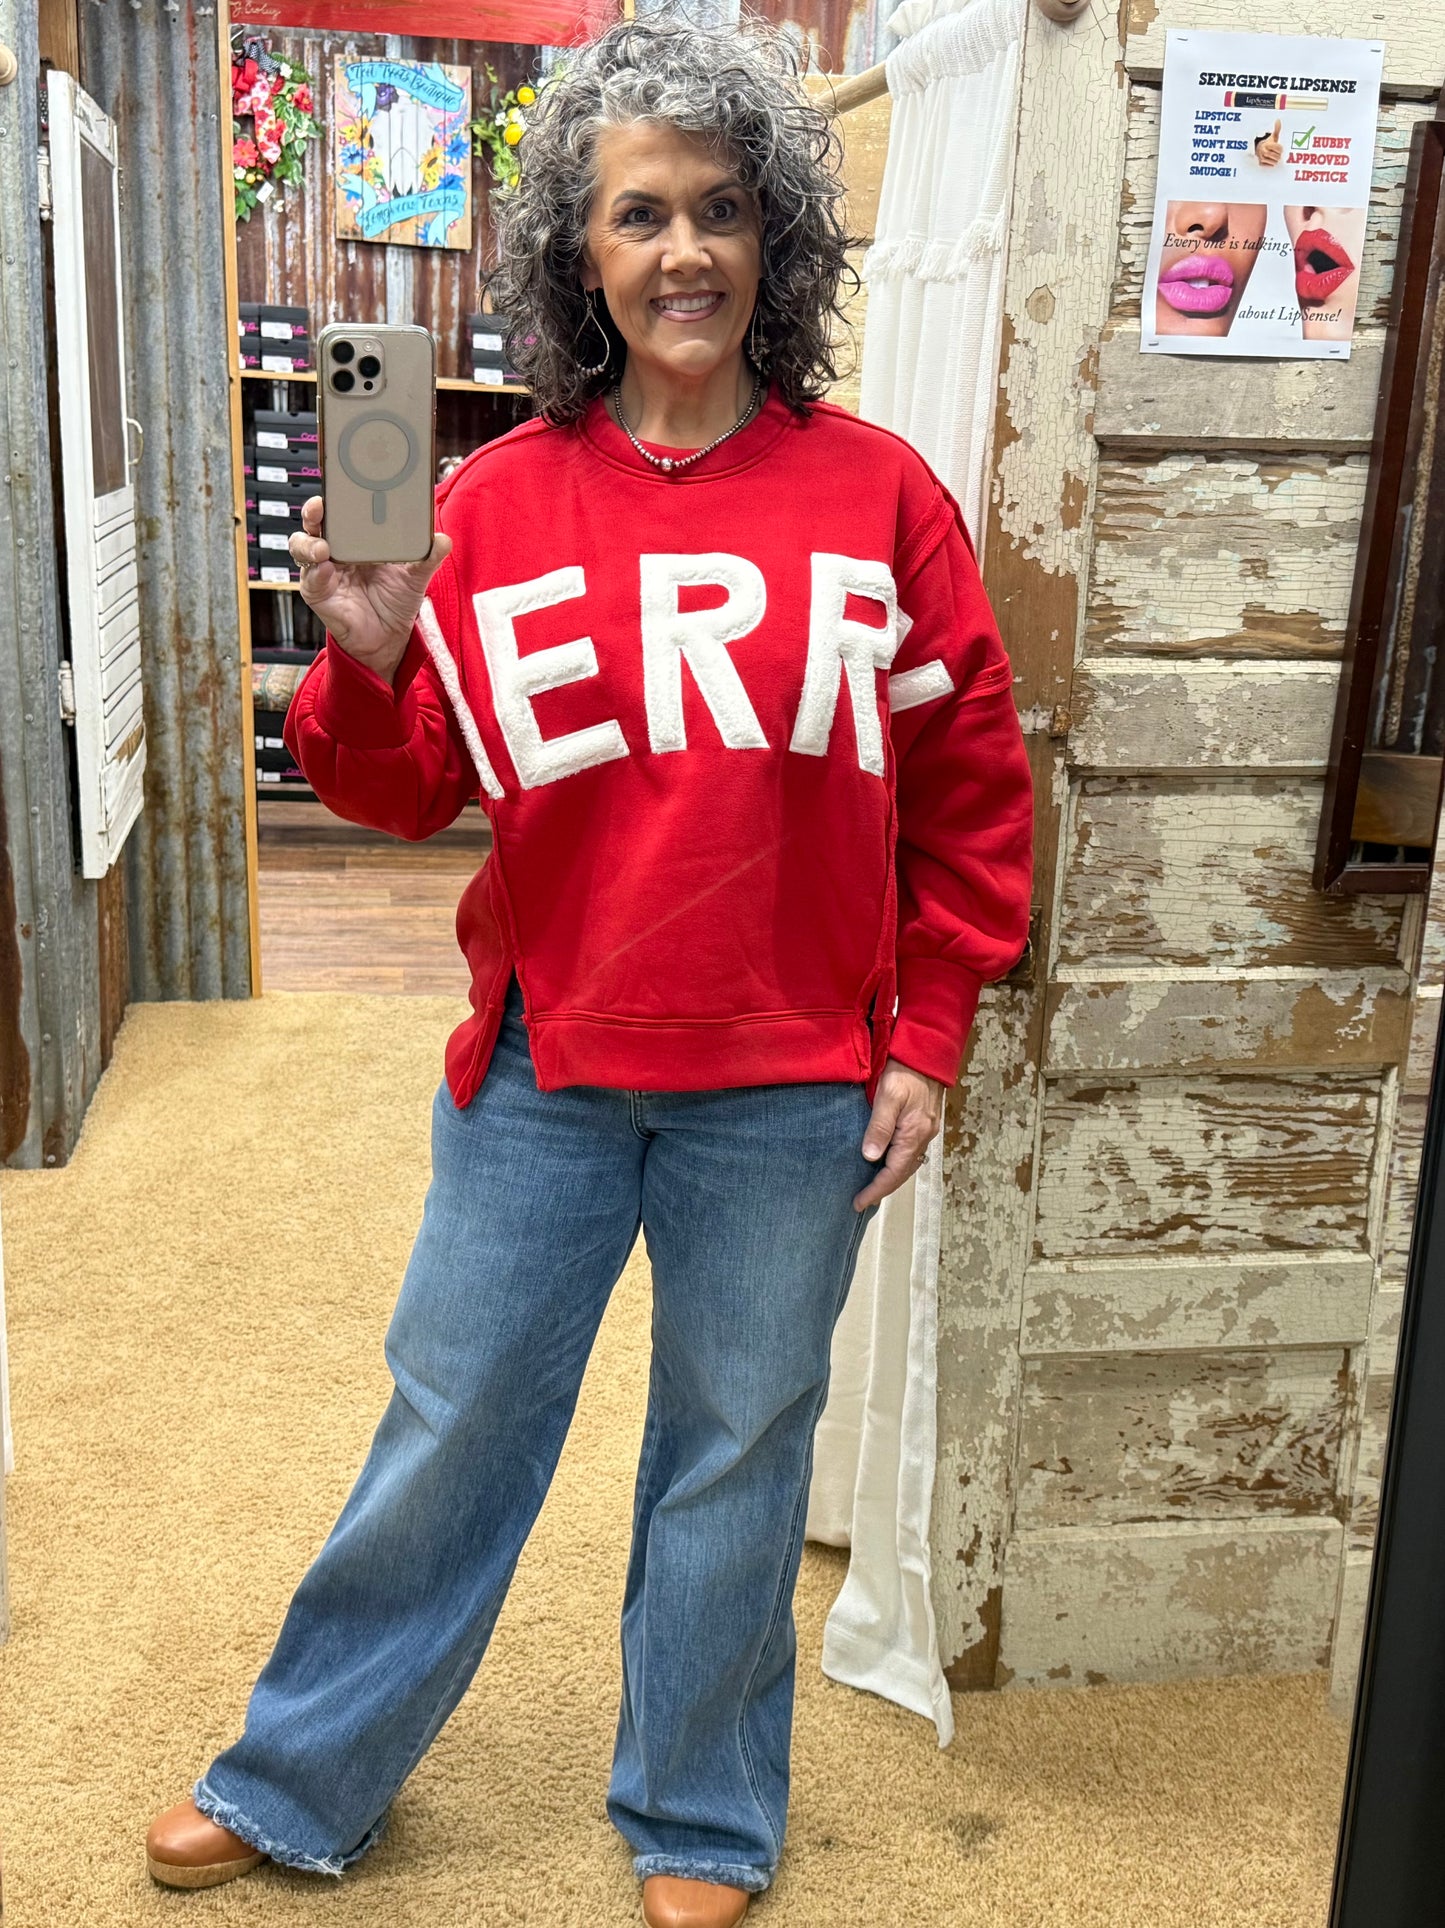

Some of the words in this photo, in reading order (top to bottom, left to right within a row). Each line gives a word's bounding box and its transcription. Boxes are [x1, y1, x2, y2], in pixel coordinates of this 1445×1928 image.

[1199, 72, 1288, 90] SENEGENCE
[1290, 77, 1357, 93] LIPSENSE
[1195, 111, 1242, 122] LIPSTICK
[1194, 125, 1220, 135] THAT
[1192, 138, 1226, 149] WON'T
[1226, 140, 1248, 150] KISS
[1312, 136, 1352, 149] HUBBY
[1191, 152, 1210, 162] OFF
[1210, 154, 1225, 163] OR
[1286, 152, 1350, 166] APPROVED
[1189, 166, 1232, 177] SMUDGE
[1294, 170, 1348, 183] LIPSTICK
[420, 193, 458, 209] Texas
[1229, 236, 1239, 250] is
[1238, 305, 1276, 320] about
[1277, 306, 1342, 326] LipSense!
